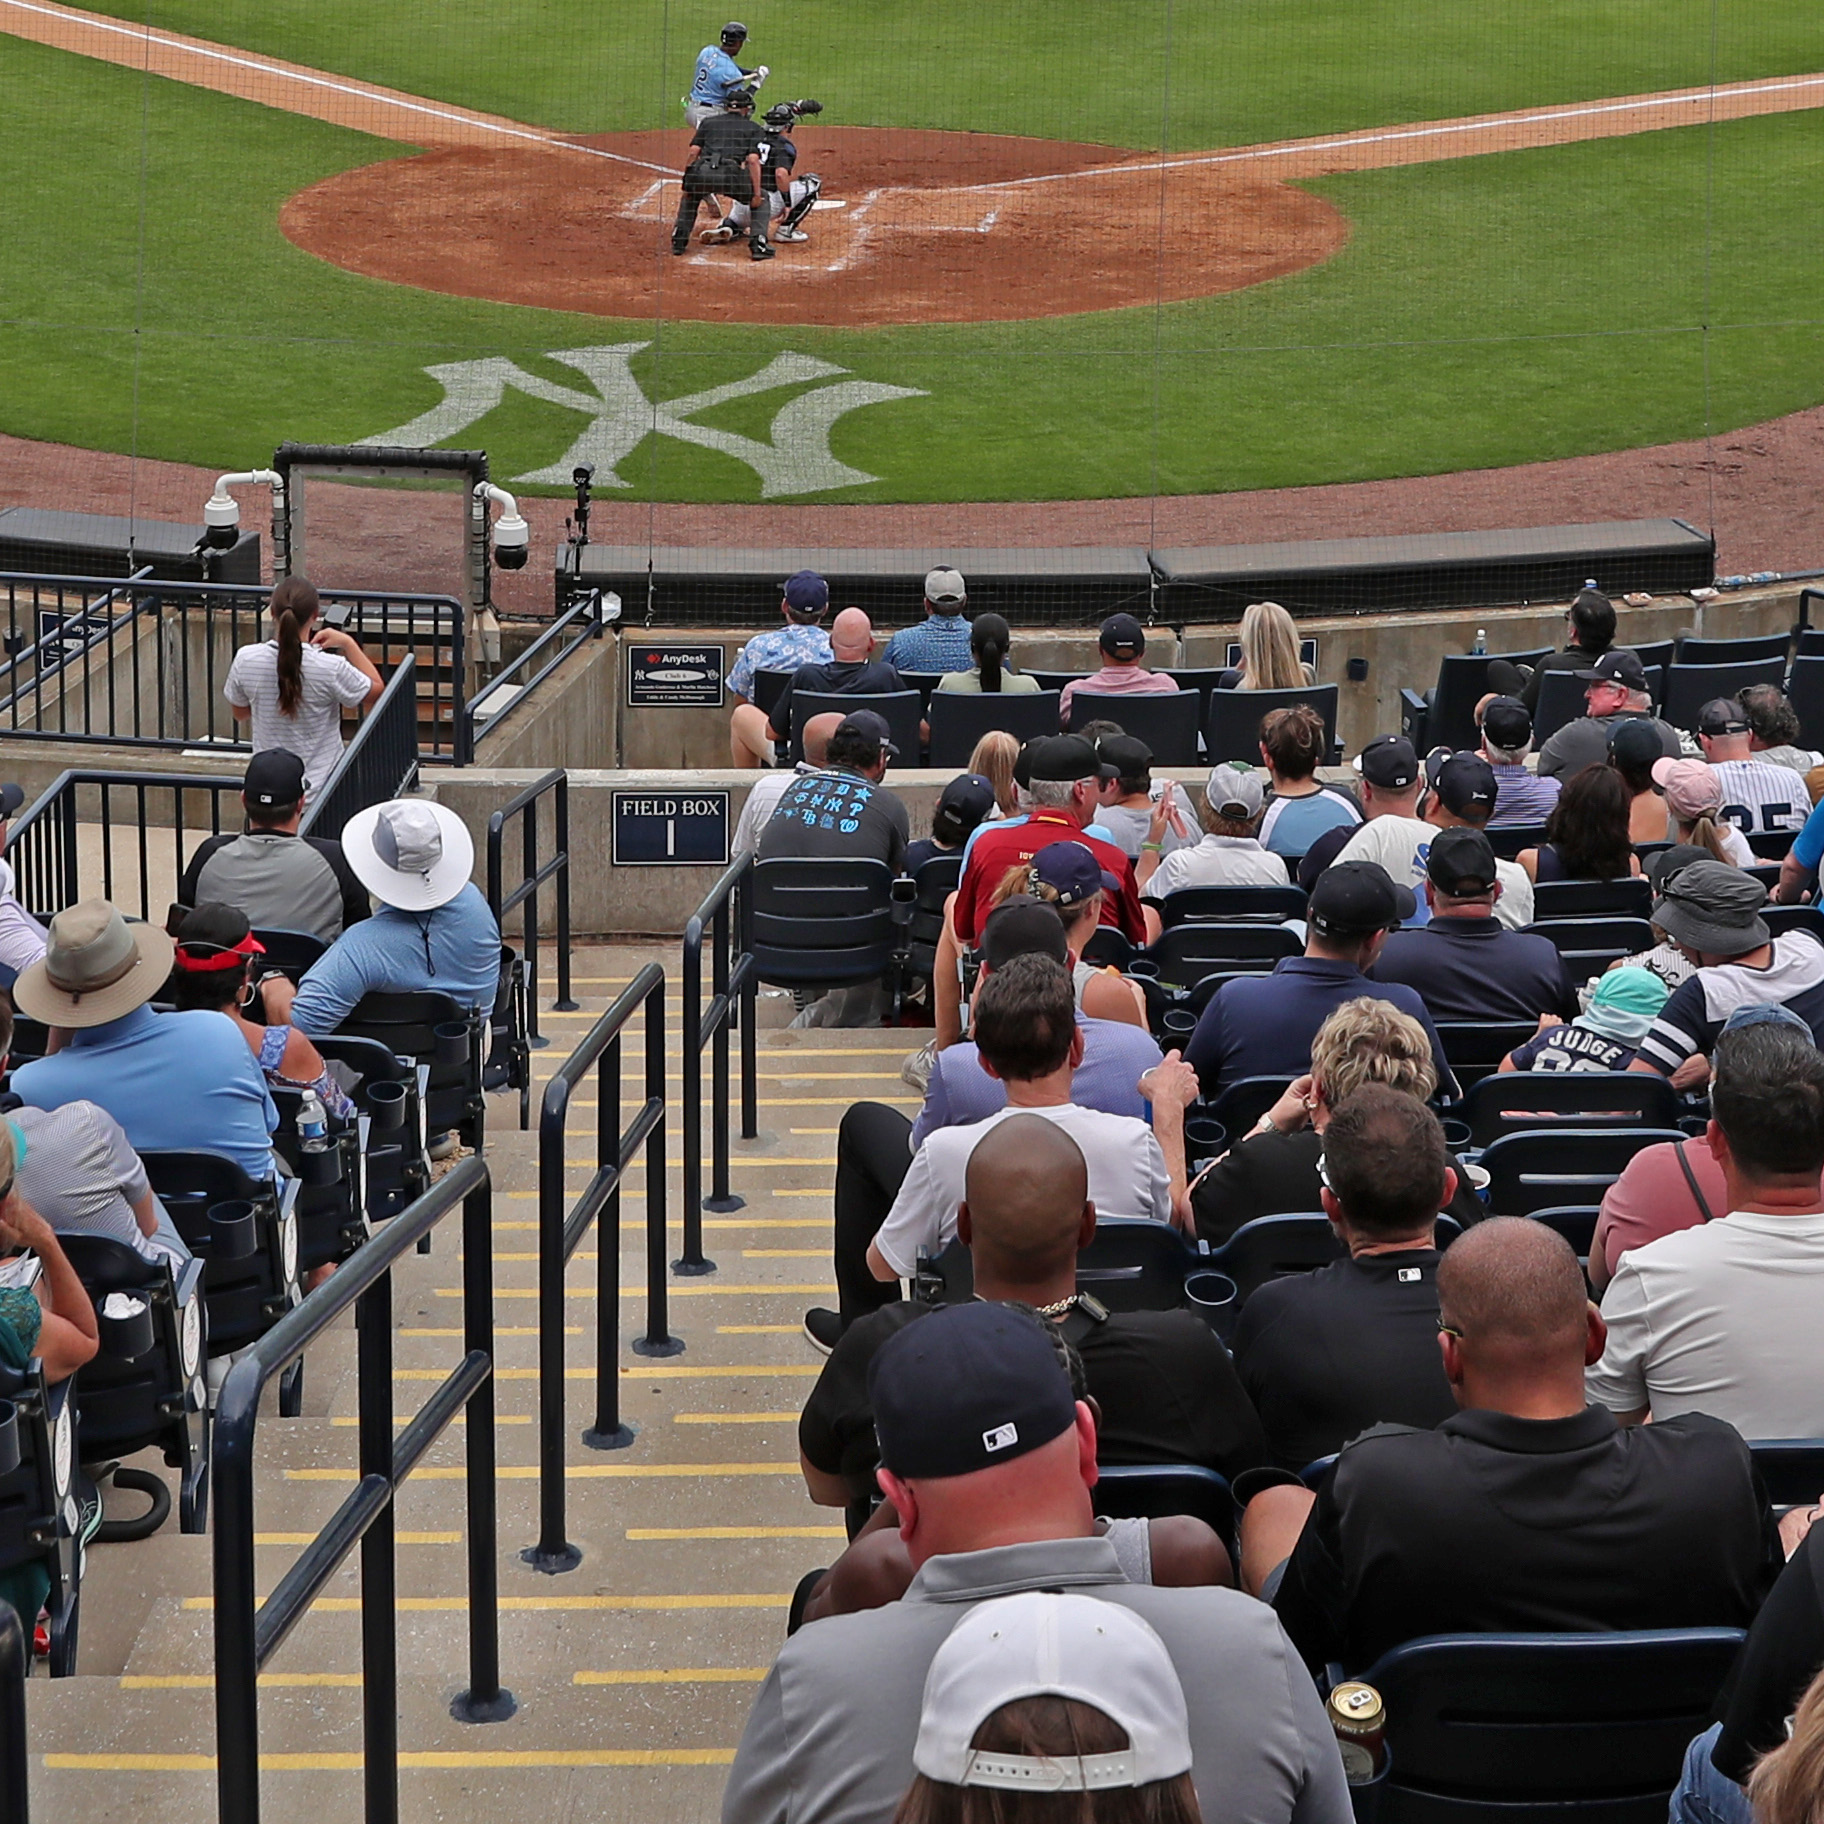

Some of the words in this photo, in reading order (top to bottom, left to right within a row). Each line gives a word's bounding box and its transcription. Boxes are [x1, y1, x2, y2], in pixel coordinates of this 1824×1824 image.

[693, 68, 709, 94] 2
[661, 653, 707, 666] AnyDesk
[621, 799, 677, 816] FIELD
[681, 799, 721, 816] BOX
[1548, 1029, 1623, 1064] JUDGE
